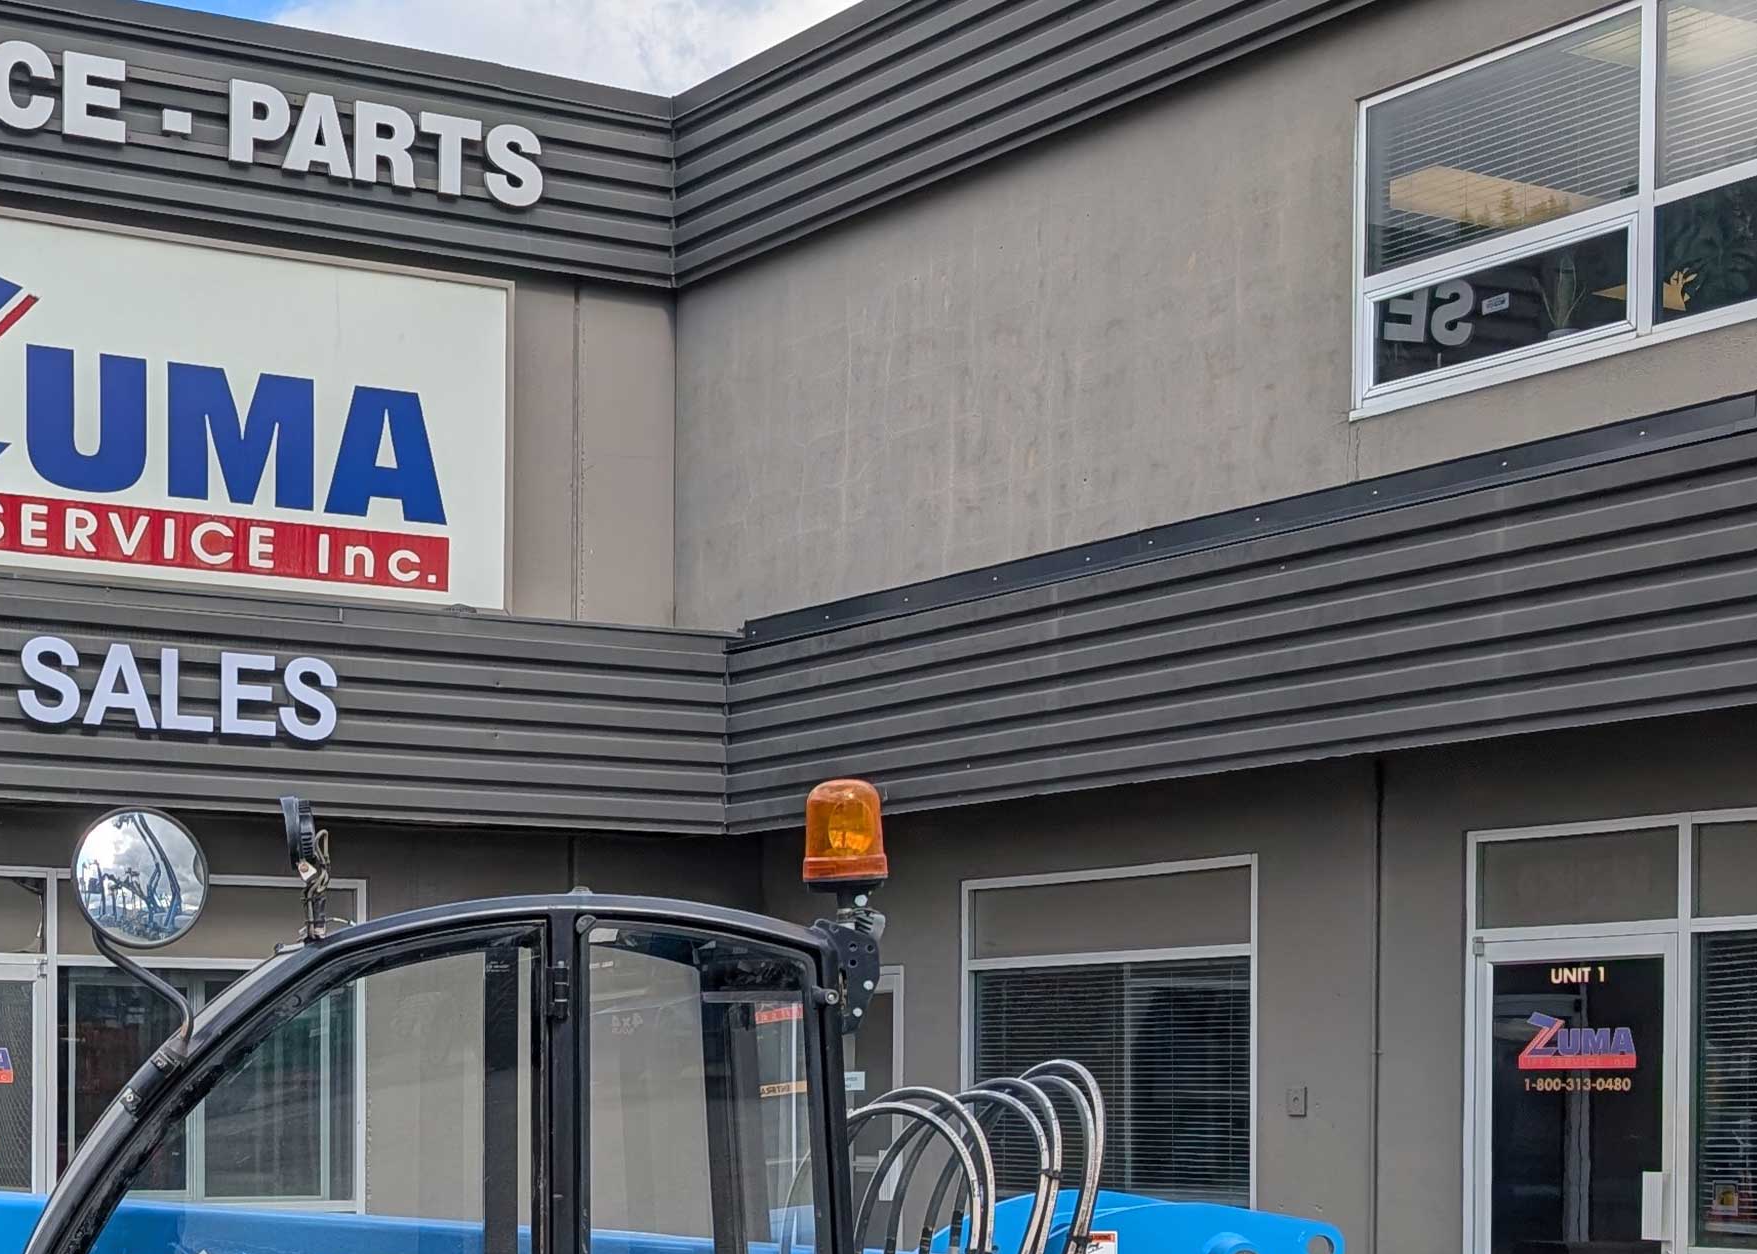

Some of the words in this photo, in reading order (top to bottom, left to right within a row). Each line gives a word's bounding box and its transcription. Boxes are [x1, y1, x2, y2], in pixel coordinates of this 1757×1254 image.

[228, 78, 543, 208] PARTS
[319, 533, 437, 584] Inc.
[17, 635, 337, 743] SALES
[1550, 967, 1592, 984] UNIT
[1598, 966, 1605, 982] 1
[1520, 1012, 1636, 1056] ZUMA
[1524, 1077, 1632, 1091] 1-800-313-0480
